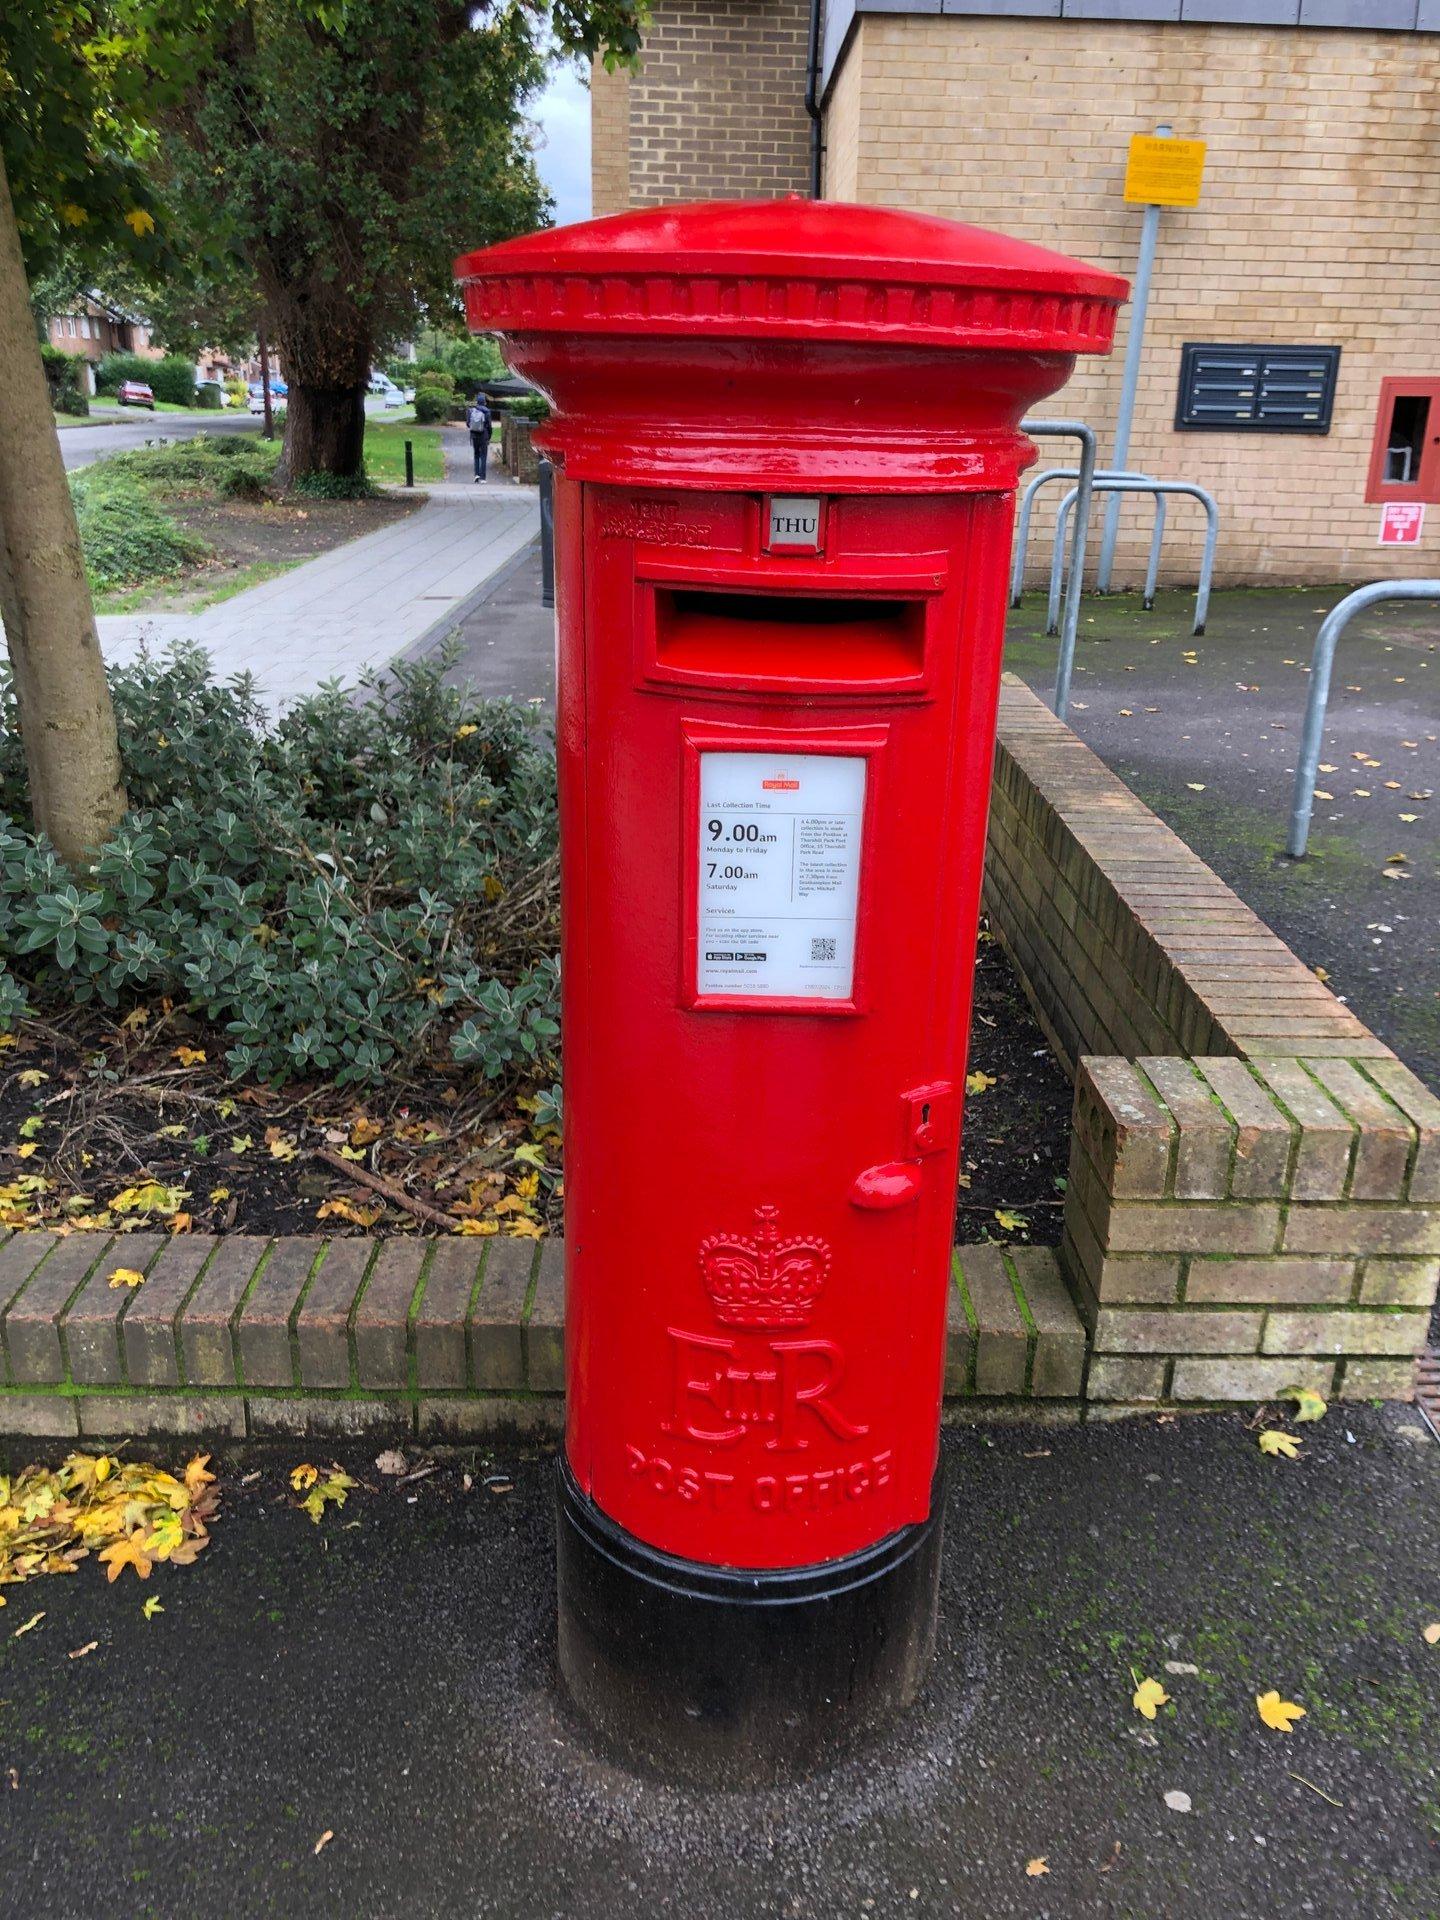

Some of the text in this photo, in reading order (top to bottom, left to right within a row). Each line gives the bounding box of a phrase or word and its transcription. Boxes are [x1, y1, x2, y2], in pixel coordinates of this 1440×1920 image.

[1144, 142, 1190, 154] WARNING
[773, 516, 817, 533] THU
[764, 781, 782, 789] Royal
[708, 819, 777, 842] 9.00am
[706, 846, 734, 854] Monday
[746, 847, 768, 855] Friday
[707, 863, 759, 879] 7.00am
[625, 1443, 892, 1511] POST OFFICE
